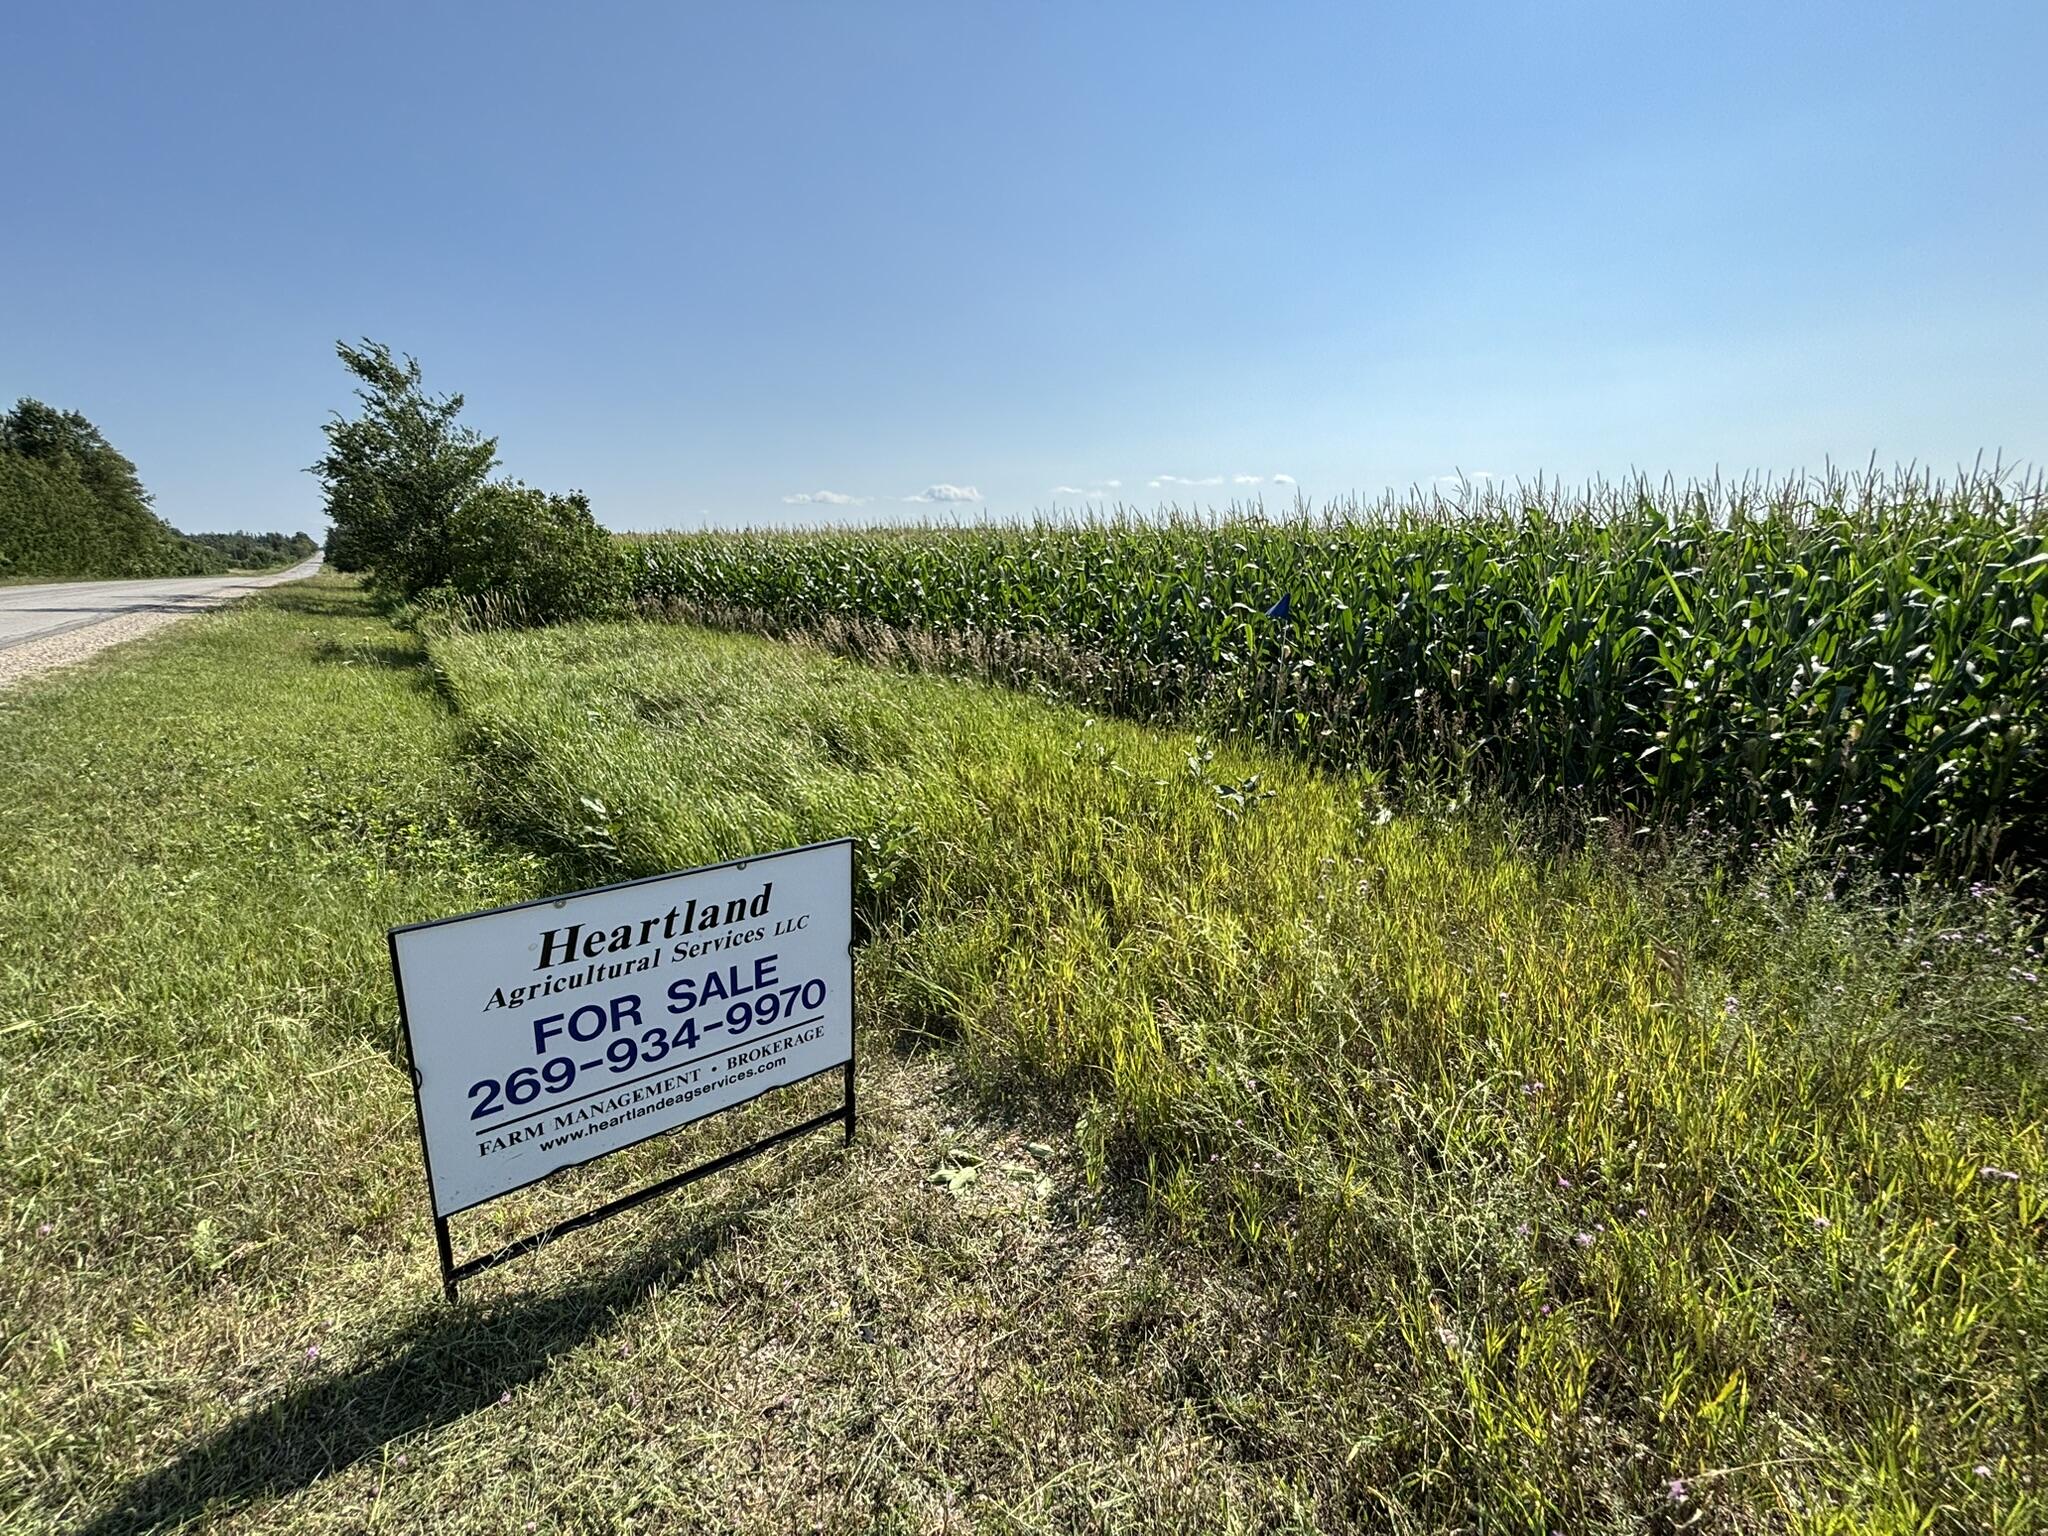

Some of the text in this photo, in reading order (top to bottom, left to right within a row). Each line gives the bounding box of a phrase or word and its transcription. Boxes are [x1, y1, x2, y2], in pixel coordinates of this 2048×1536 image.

[483, 914, 810, 1012] Agricultural Services LLC
[532, 882, 773, 971] Heartland
[468, 978, 826, 1120] 269-934-9970
[533, 954, 779, 1055] FOR SALE
[478, 1025, 825, 1157] FARM MANAGEMENT BROKERAGE
[540, 1055, 786, 1152] www.heartlandeagservices.com
